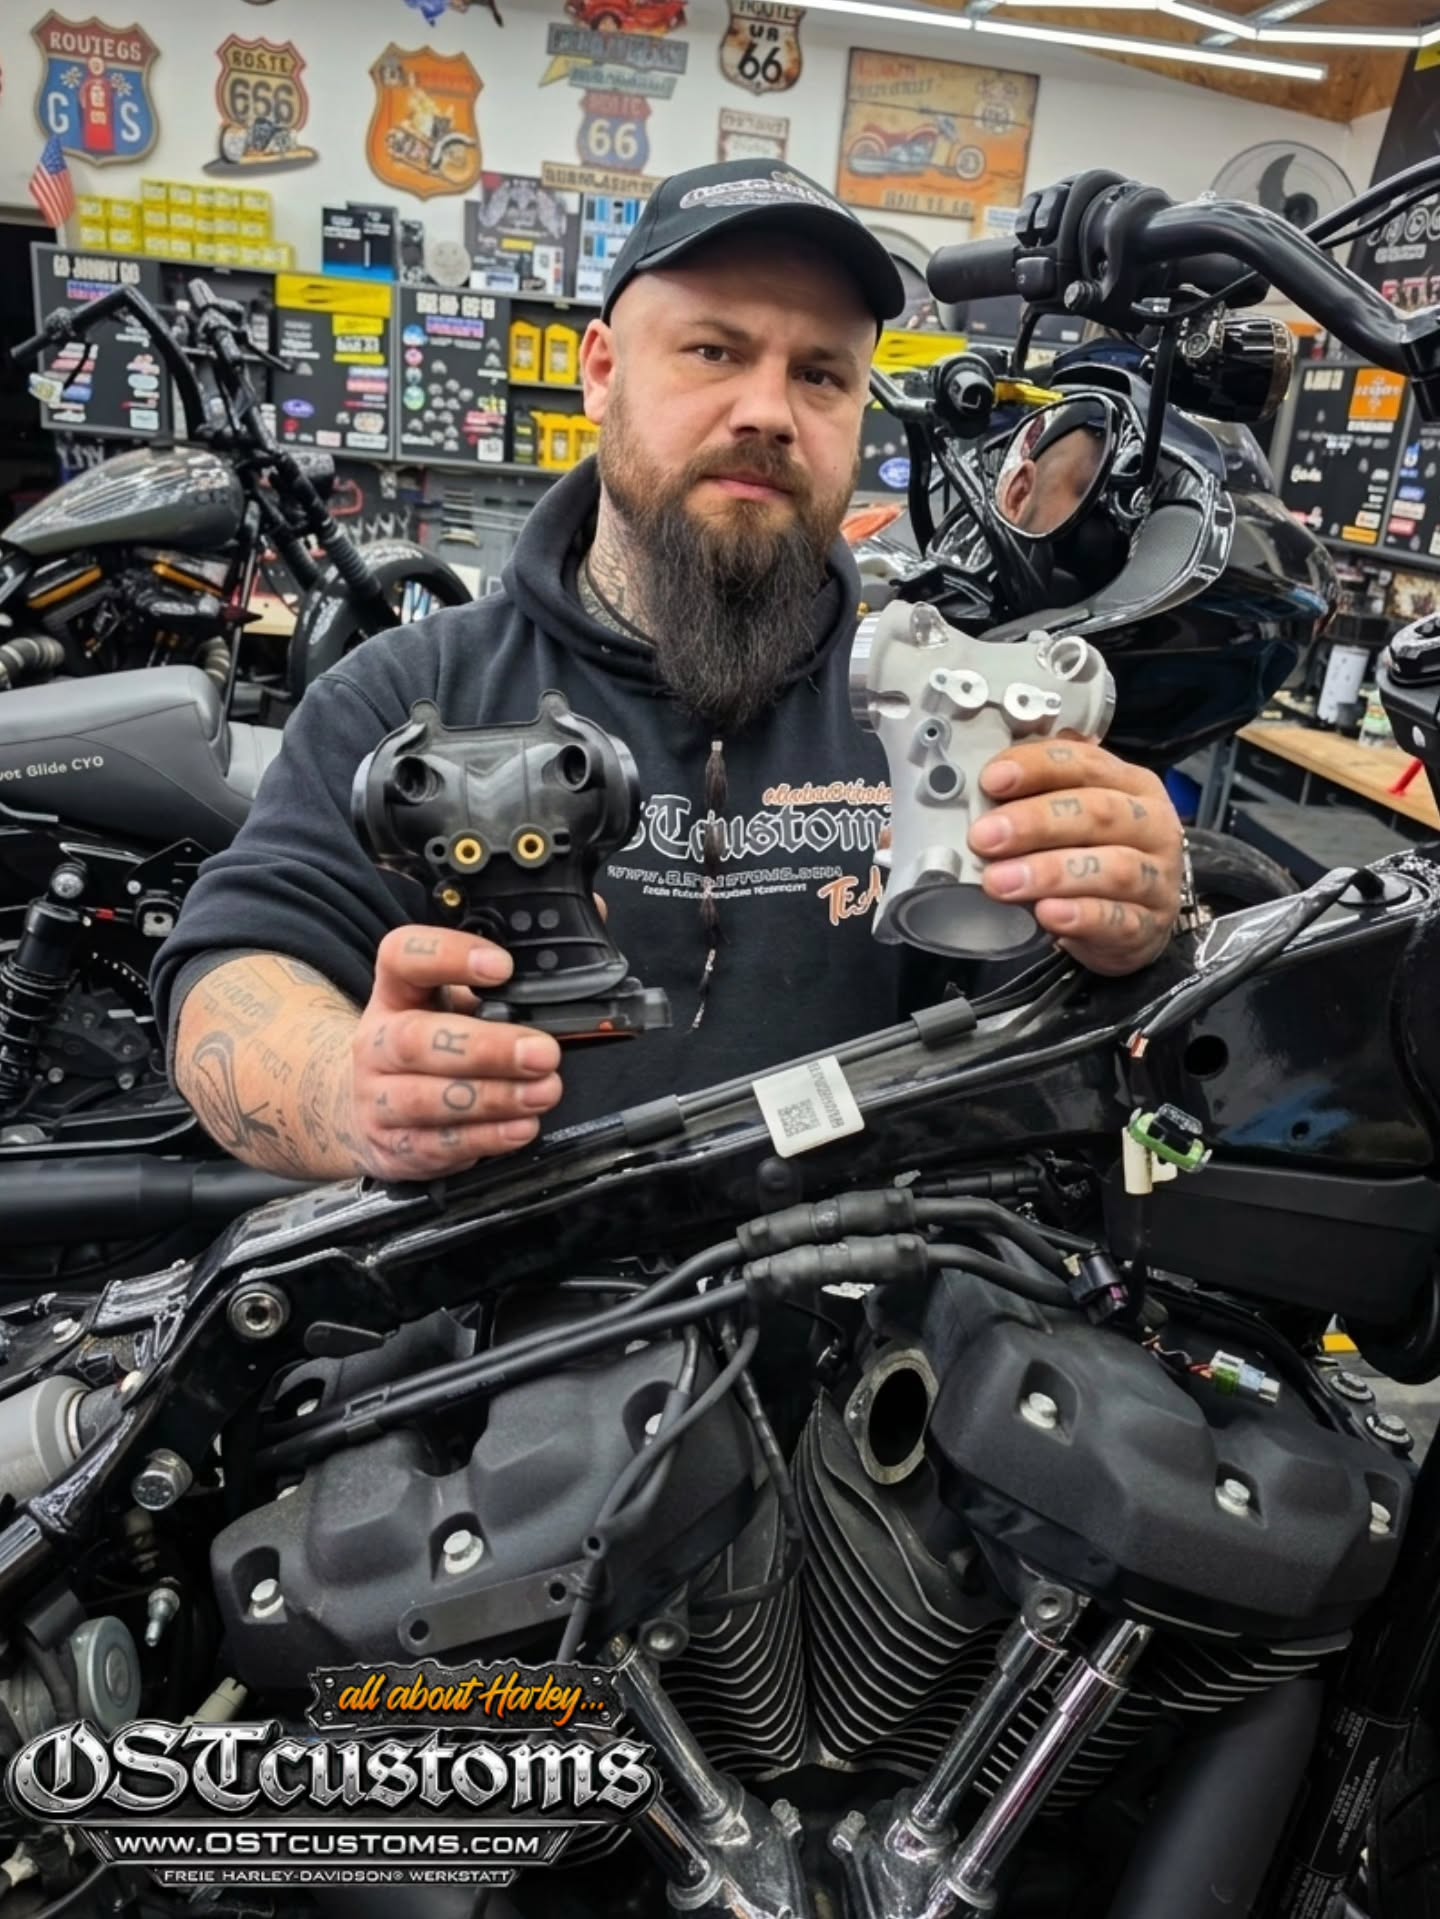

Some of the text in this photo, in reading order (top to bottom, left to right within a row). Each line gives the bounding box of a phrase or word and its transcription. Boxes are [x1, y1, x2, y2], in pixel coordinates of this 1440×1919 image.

[738, 43, 782, 84] 66
[230, 78, 294, 124] 666
[587, 118, 639, 161] 66
[26, 762, 68, 778] Glide
